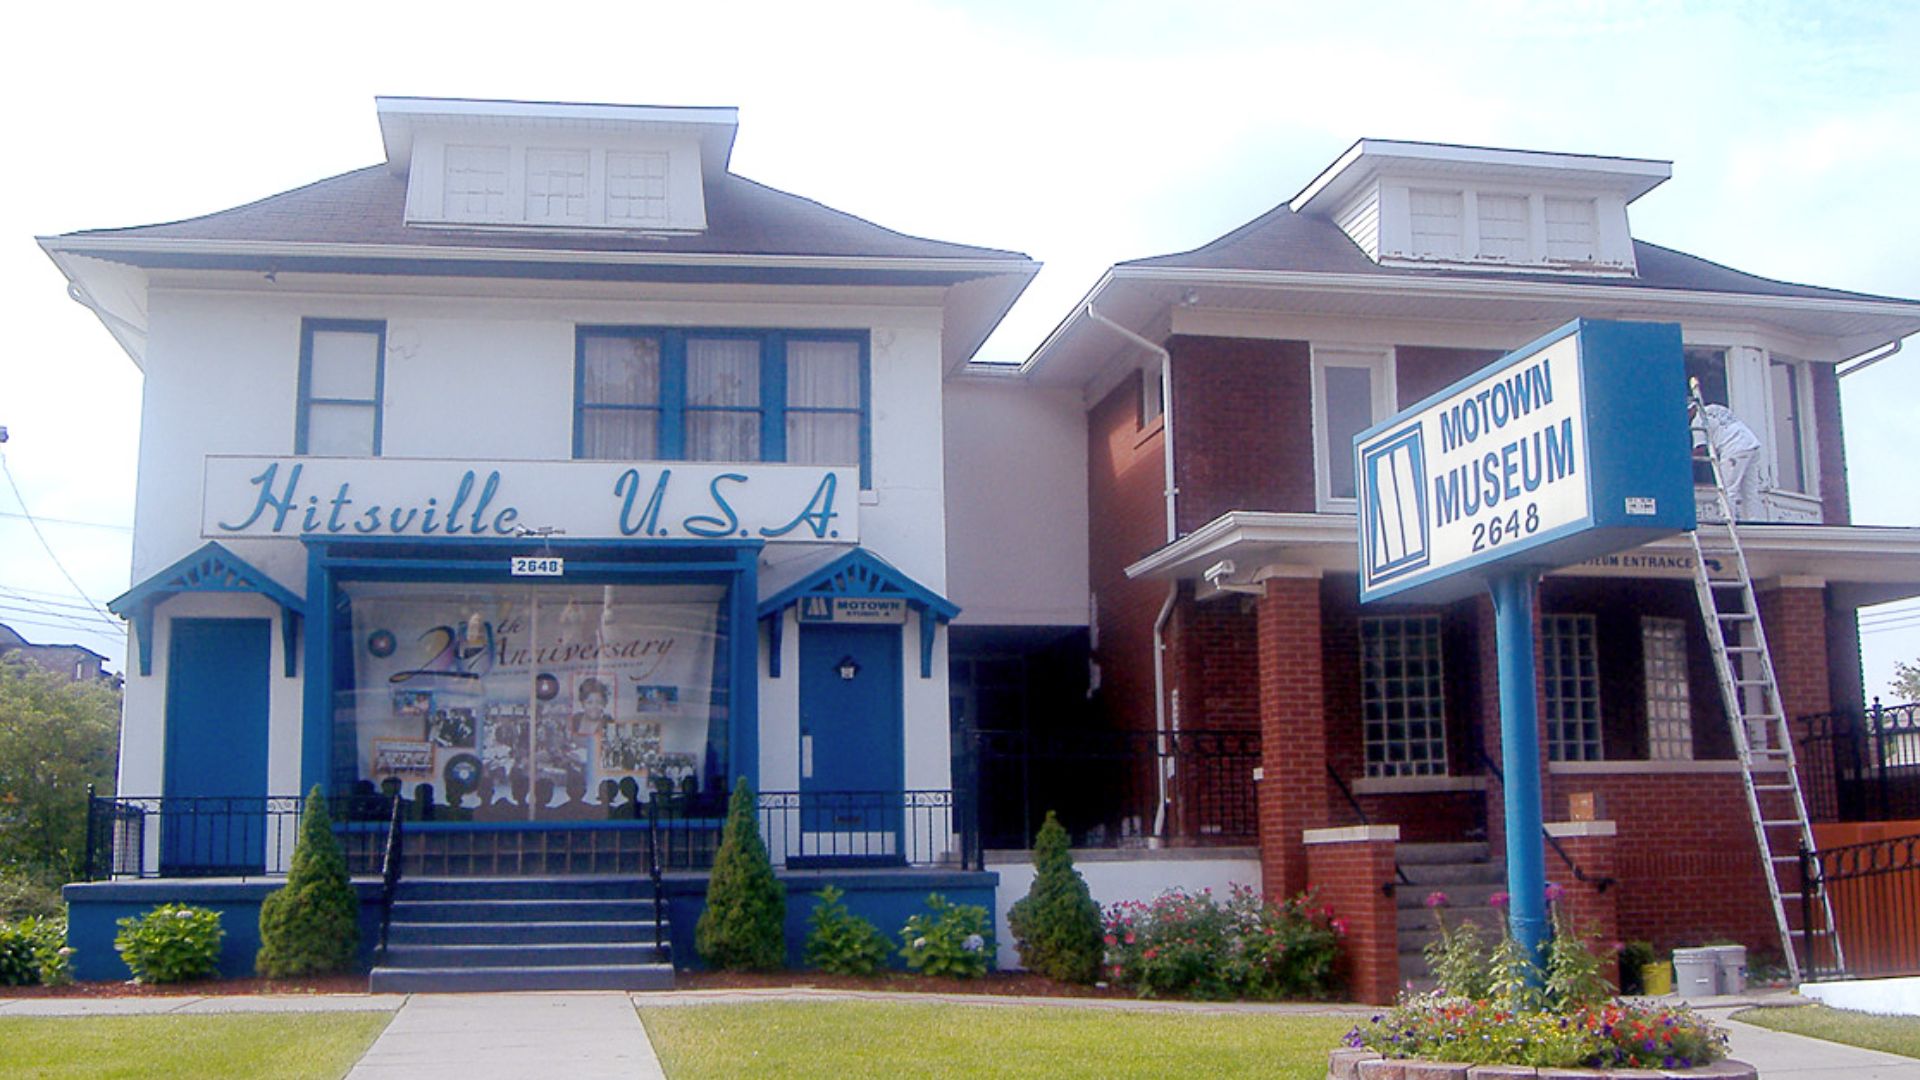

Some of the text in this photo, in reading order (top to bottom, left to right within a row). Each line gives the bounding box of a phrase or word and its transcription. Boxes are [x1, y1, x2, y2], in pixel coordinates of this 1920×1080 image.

[1440, 358, 1553, 454] MOTOWN
[218, 462, 518, 533] Hitsville
[1434, 416, 1576, 528] MUSEUM
[1471, 502, 1539, 553] 2648
[517, 560, 558, 573] 2648
[1623, 555, 1693, 569] ENTRANCE
[837, 601, 900, 610] MOTOWN
